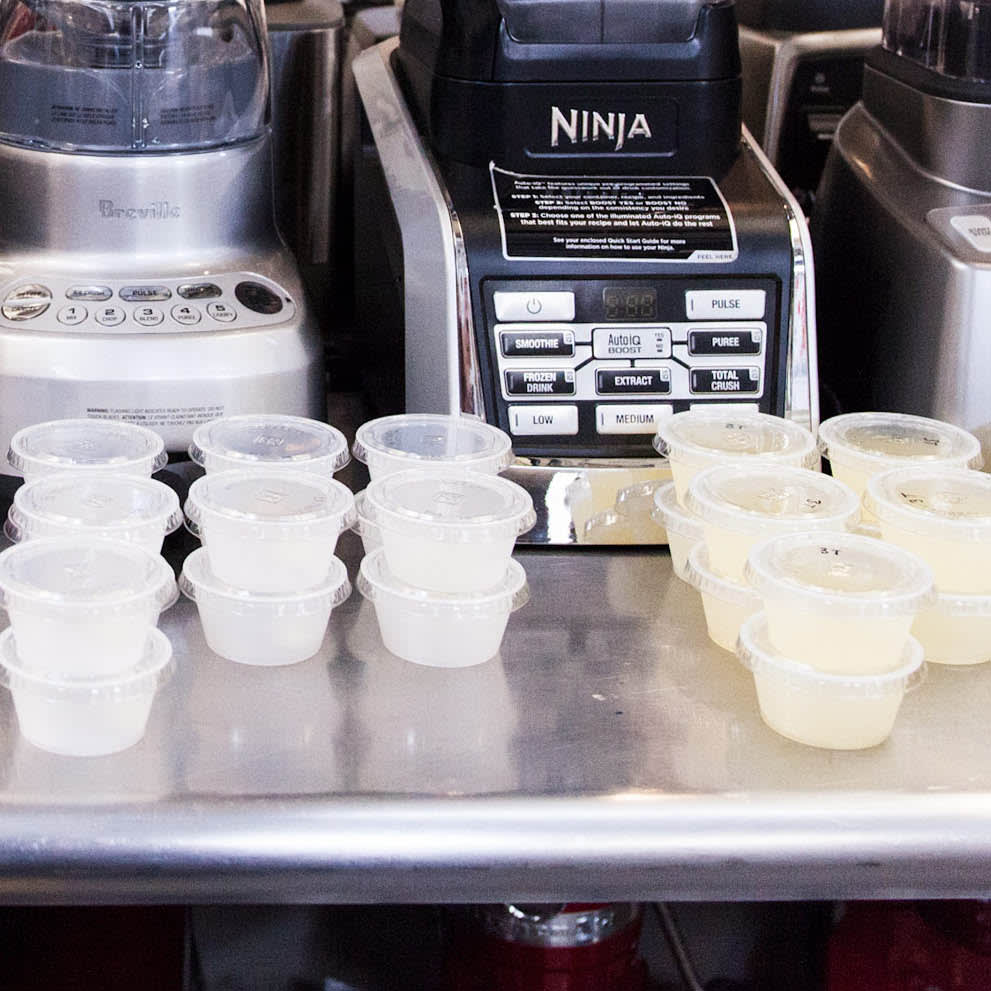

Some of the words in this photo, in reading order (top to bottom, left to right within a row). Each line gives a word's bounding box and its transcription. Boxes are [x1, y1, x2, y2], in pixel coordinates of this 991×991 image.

[551, 105, 652, 151] NINJA
[711, 299, 741, 309] PULSE
[515, 338, 559, 349] SMOOTHIE
[711, 337, 740, 347] PUREE
[608, 346, 641, 354] BOOST
[523, 372, 557, 382] FROZEN
[711, 370, 739, 381] TOTAL
[614, 376, 653, 386] EXTRACT
[711, 380, 740, 391] CRUSH
[526, 383, 554, 393] DRINK
[533, 415, 554, 425] LOW
[616, 414, 655, 424] MEDIUM
